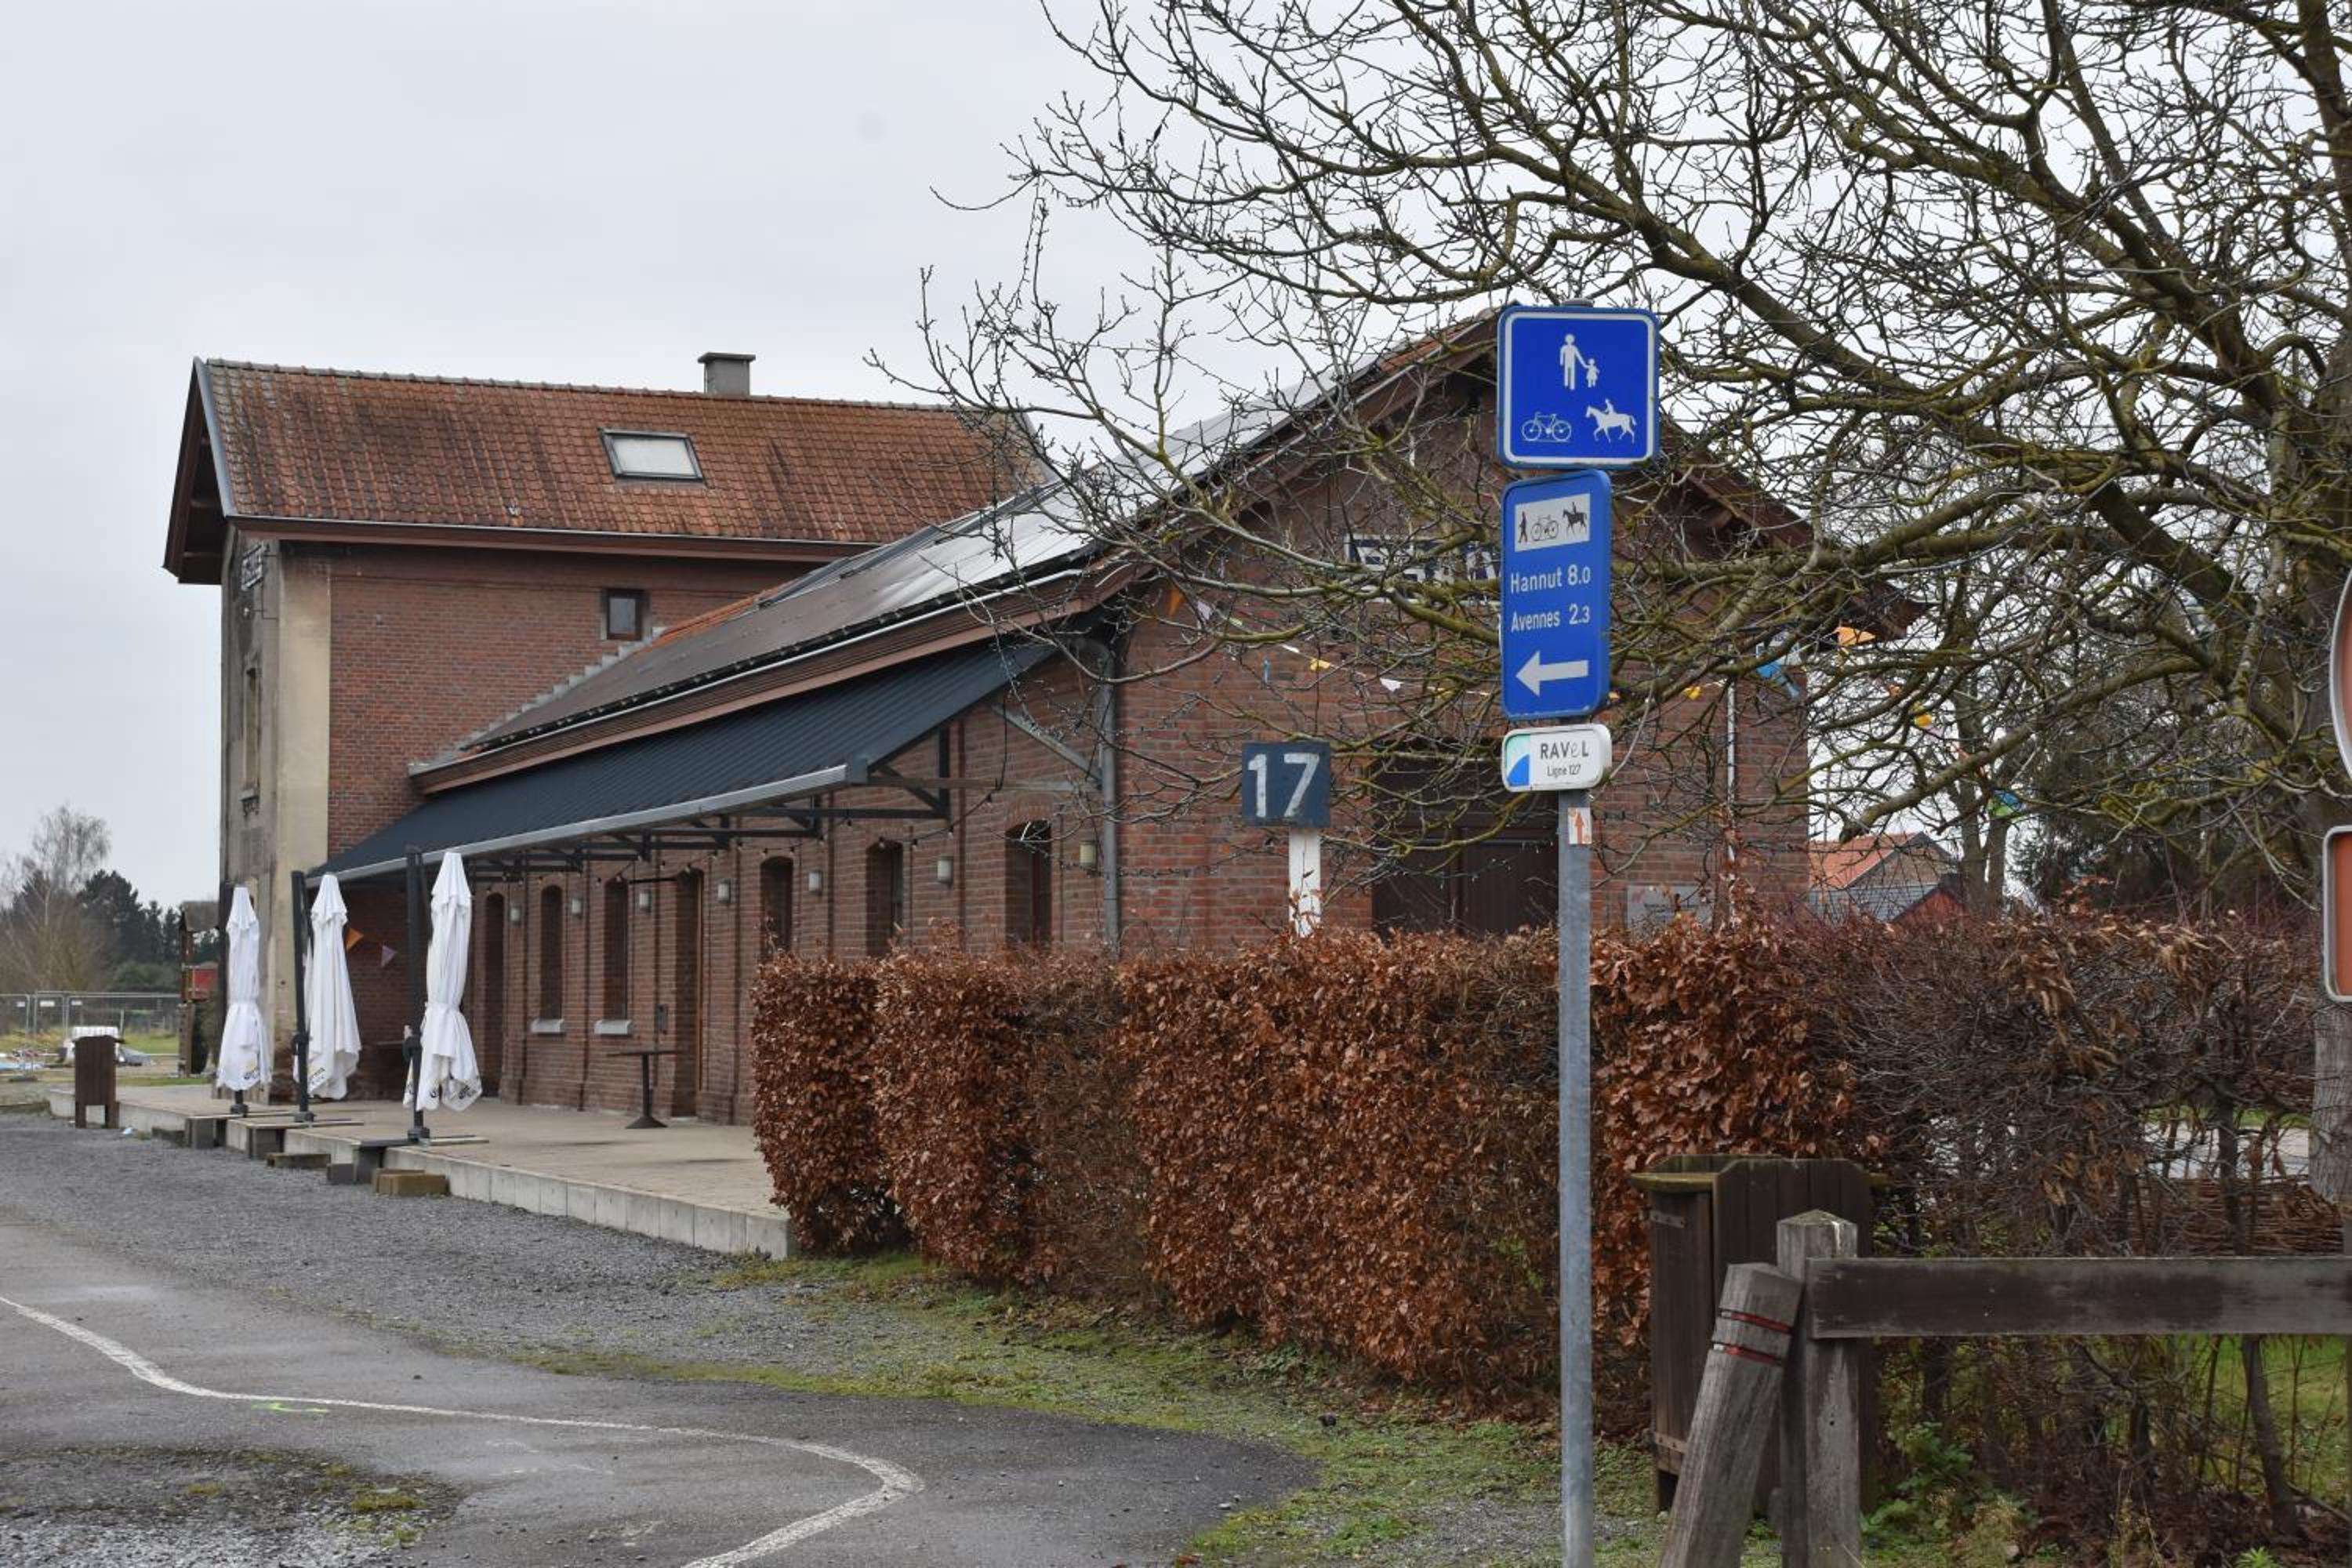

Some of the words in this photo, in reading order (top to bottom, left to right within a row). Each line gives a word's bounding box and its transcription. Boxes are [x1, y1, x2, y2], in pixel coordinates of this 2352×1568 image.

[1511, 566, 1563, 593] Hannut
[1567, 564, 1591, 586] 8.0
[1511, 611, 1560, 633] Avennes
[1569, 603, 1591, 625] 2.3
[1248, 752, 1320, 818] 17
[1547, 764, 1567, 779] Ligne
[1569, 764, 1581, 775] 127
